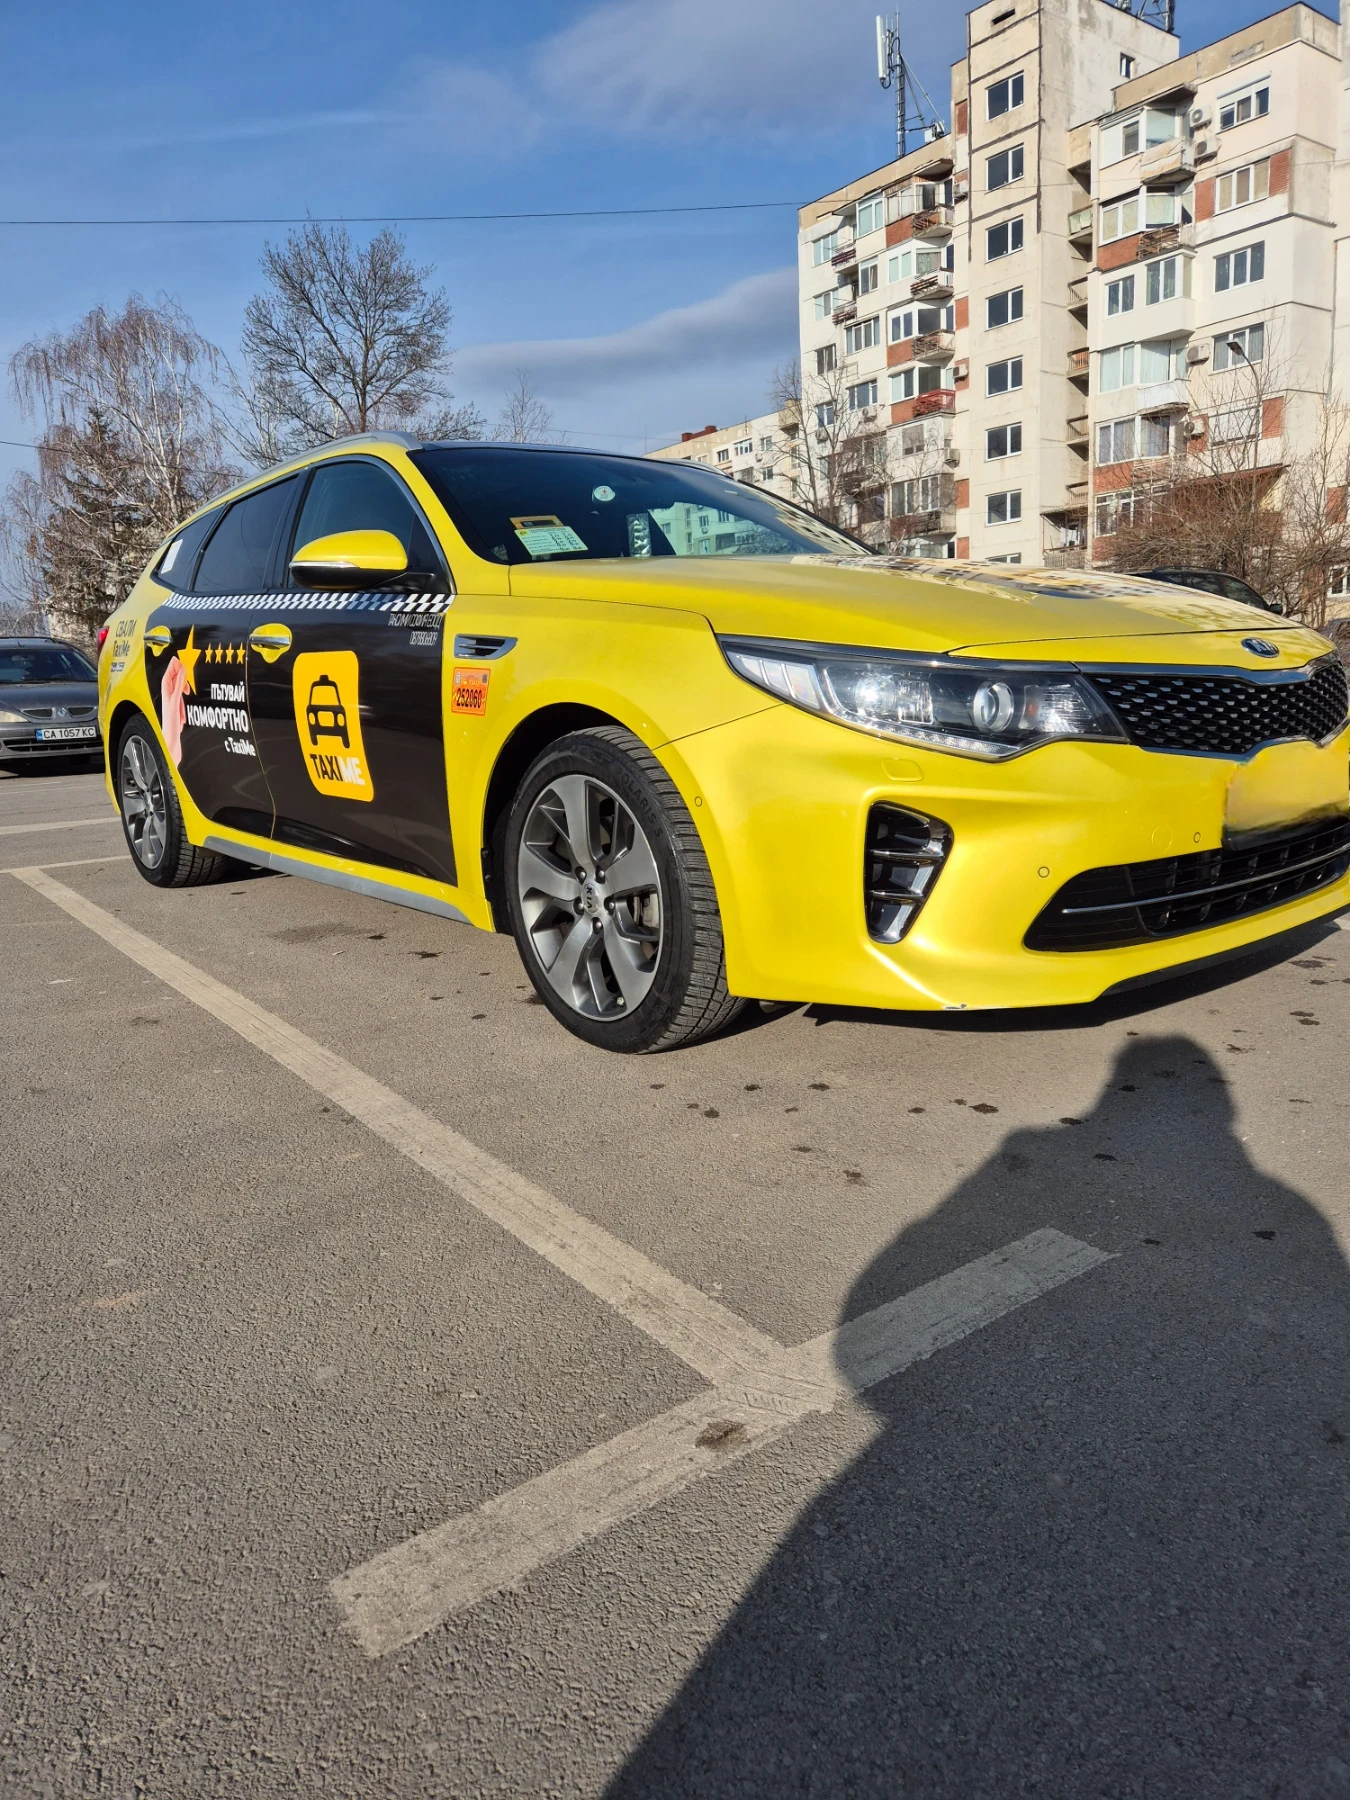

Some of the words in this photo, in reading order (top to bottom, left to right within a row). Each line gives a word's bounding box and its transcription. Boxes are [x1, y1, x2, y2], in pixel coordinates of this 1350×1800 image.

[211, 681, 245, 702] ПЪТУВАЙ
[456, 687, 483, 709] 252060
[187, 705, 249, 733] КОМФОРТНО
[59, 728, 80, 738] 1057
[229, 737, 256, 757] TaxiMe
[310, 754, 366, 785] TAXIME
